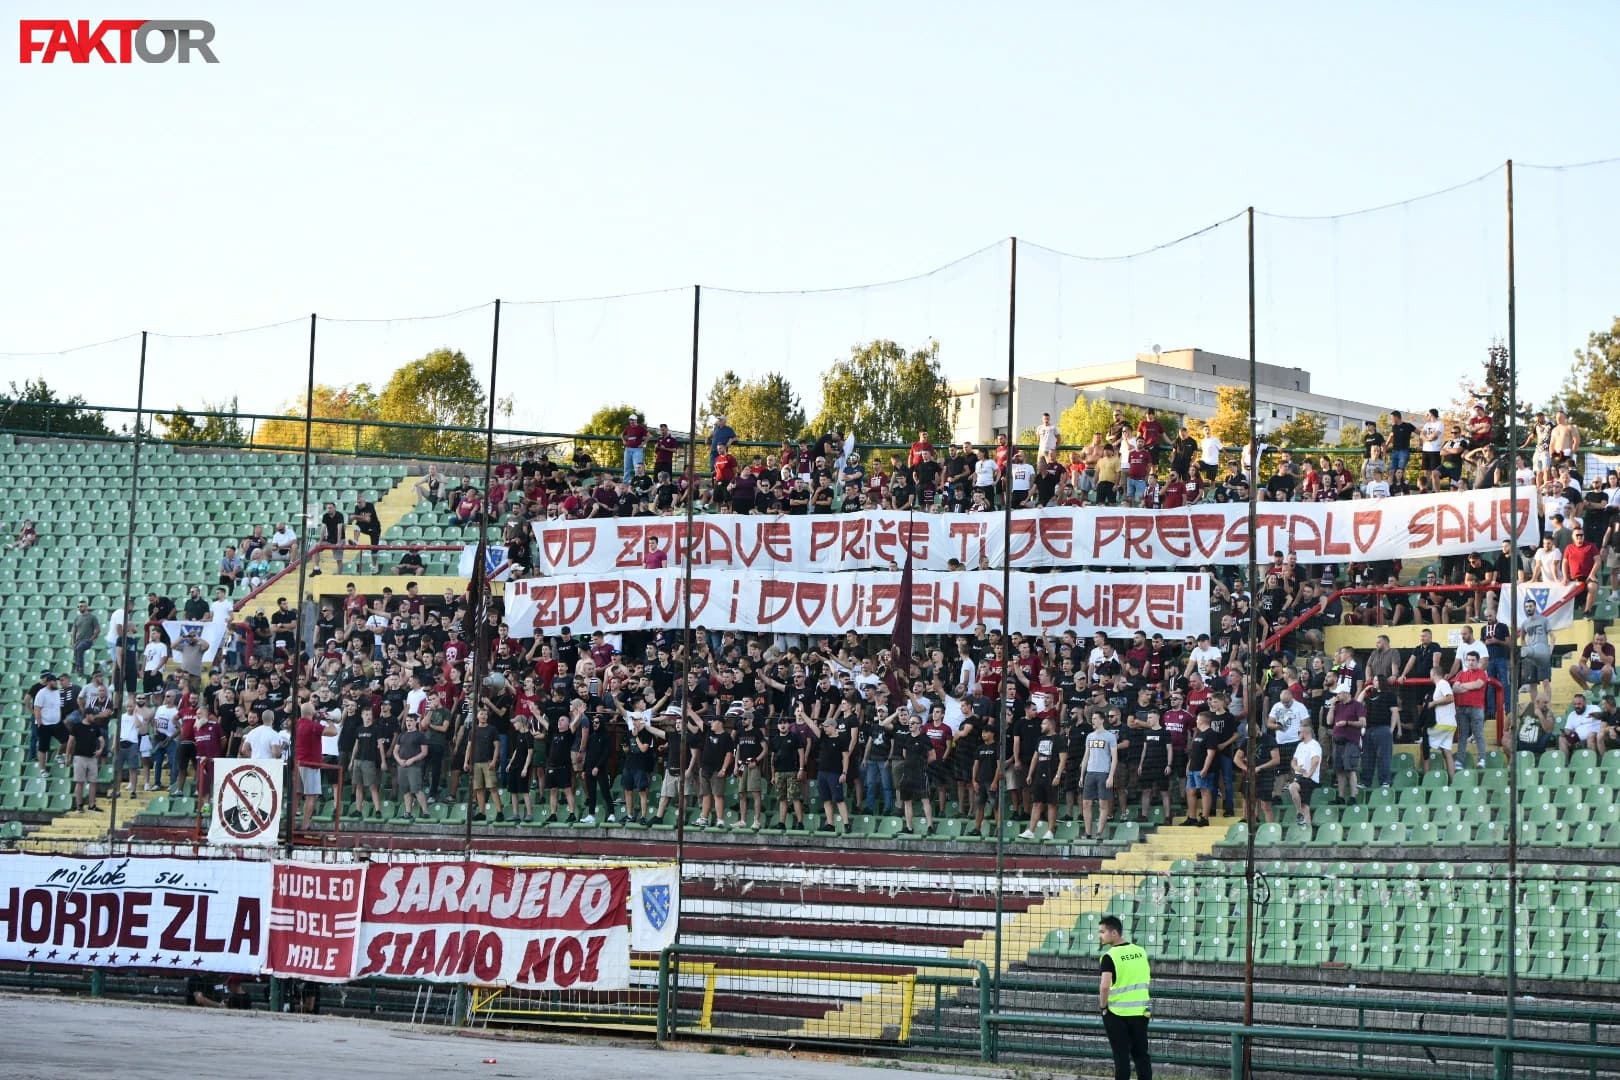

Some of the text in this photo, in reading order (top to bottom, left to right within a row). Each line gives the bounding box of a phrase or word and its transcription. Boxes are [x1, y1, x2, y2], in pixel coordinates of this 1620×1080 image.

[542, 526, 597, 567] OD
[1408, 498, 1531, 551] SAMO
[278, 872, 354, 902] NUCLEO
[371, 866, 613, 926] SARAJEVO
[159, 893, 261, 957] ZLA
[295, 911, 333, 938] DEL
[286, 943, 339, 971] MALE
[357, 928, 608, 988] SIAMO NOI
